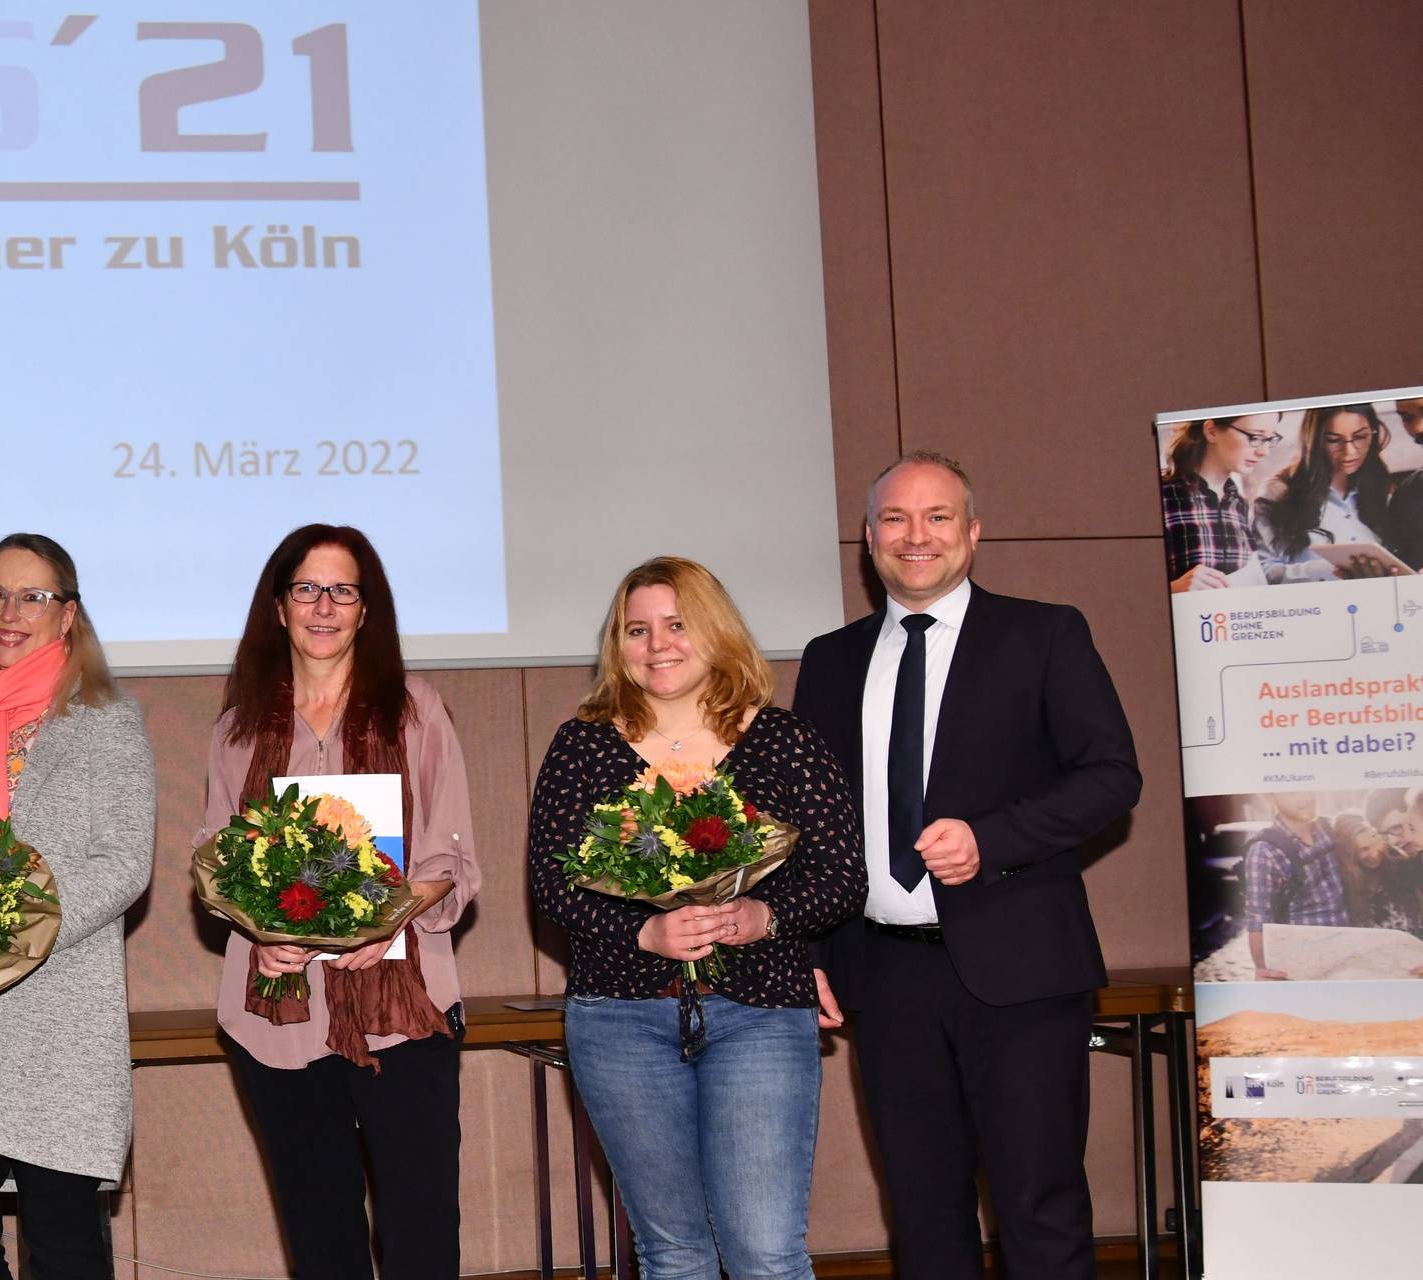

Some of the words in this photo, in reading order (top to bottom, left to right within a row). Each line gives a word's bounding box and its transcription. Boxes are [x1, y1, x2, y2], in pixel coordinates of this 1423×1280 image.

[105, 235, 184, 270] zu
[213, 225, 361, 270] Köln
[112, 441, 177, 479] 24.
[193, 440, 302, 478] März
[316, 438, 422, 476] 2022
[1230, 607, 1321, 620] BERUFSBILDUNG
[1231, 622, 1264, 631] OHNE
[1231, 631, 1285, 641] GRENZEN
[1260, 710, 1300, 729] der
[1289, 737, 1329, 756] mit
[1336, 732, 1417, 755] dabei?
